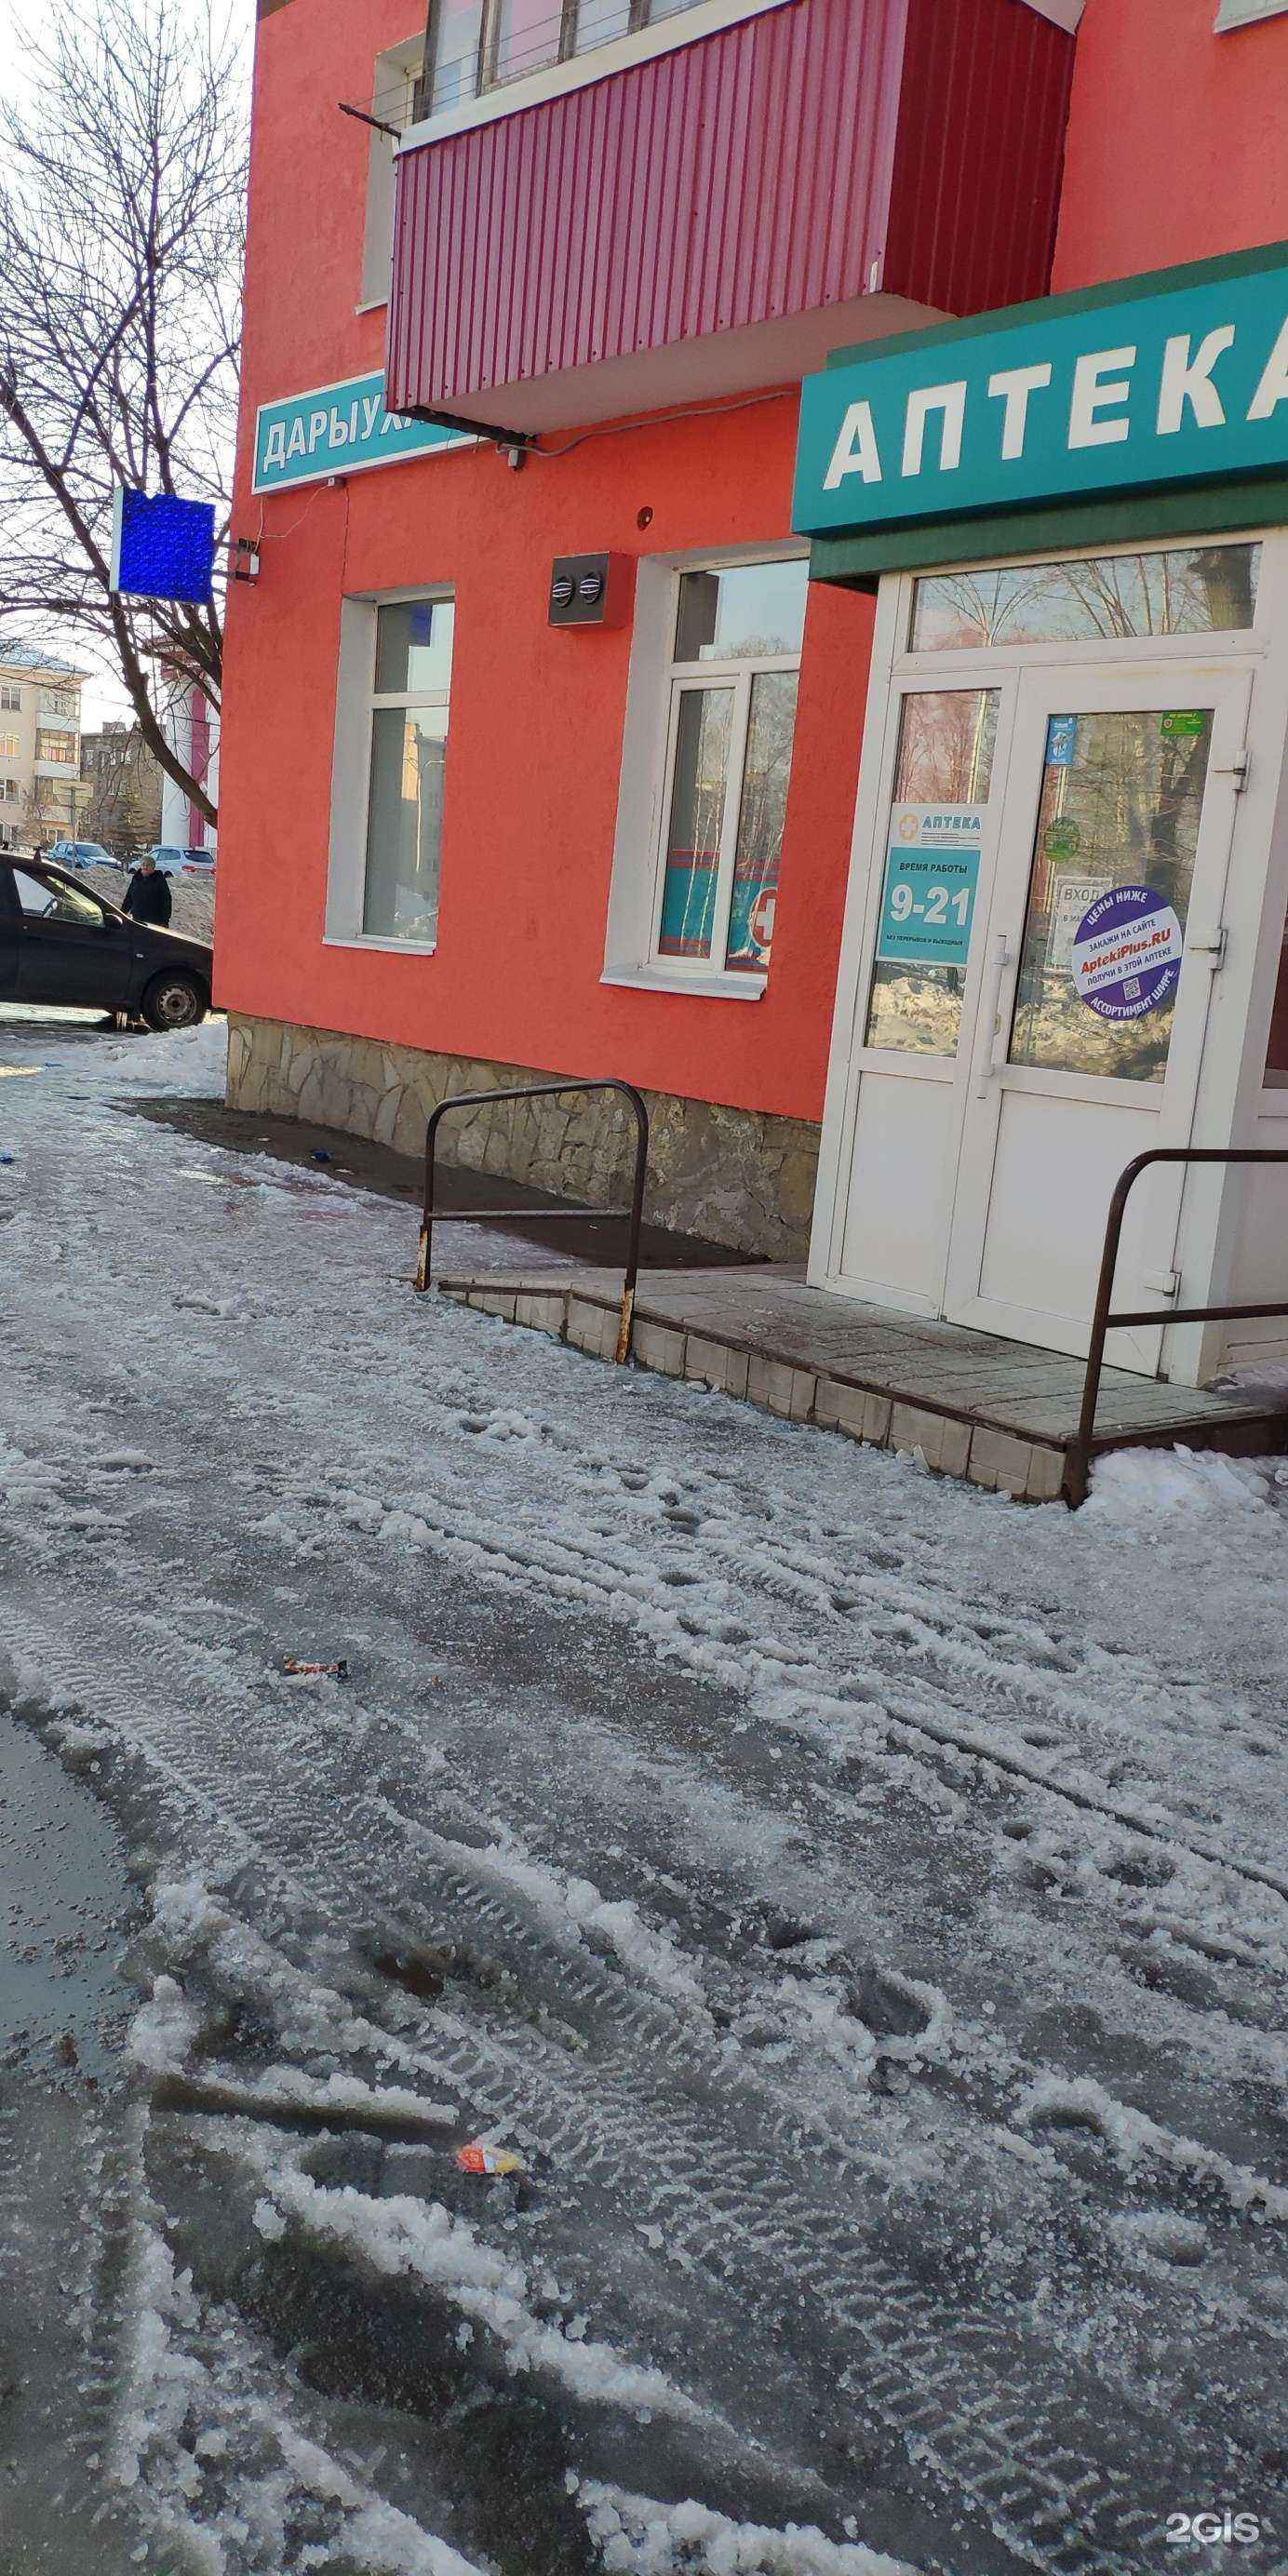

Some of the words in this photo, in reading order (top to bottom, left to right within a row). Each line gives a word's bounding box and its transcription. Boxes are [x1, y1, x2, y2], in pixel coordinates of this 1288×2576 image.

[262, 393, 424, 474] ДАРЫУ
[921, 815, 981, 830] АПТЕКА
[899, 862, 928, 872] ВРЕМЯ
[930, 864, 968, 874] РАБОТЫ
[890, 884, 970, 926] 9-21
[1086, 897, 1114, 925] ЦЕНЫ
[1116, 890, 1148, 904] НИЖЕ
[1080, 928, 1171, 974] AptekiPlus.RU
[1089, 933, 1119, 953] ЗАКАЖИ
[1120, 928, 1132, 939] НА
[1133, 919, 1157, 933] САЙТЕ
[1087, 967, 1116, 986] ПОЛУЧИ
[1118, 964, 1123, 974] В
[1124, 957, 1143, 973] ЭТОЙ
[1145, 946, 1173, 963] АПТЕКЕ
[1090, 997, 1153, 1017] АССОРТИМЕНТ
[1152, 968, 1176, 1001] ШИРЕ
